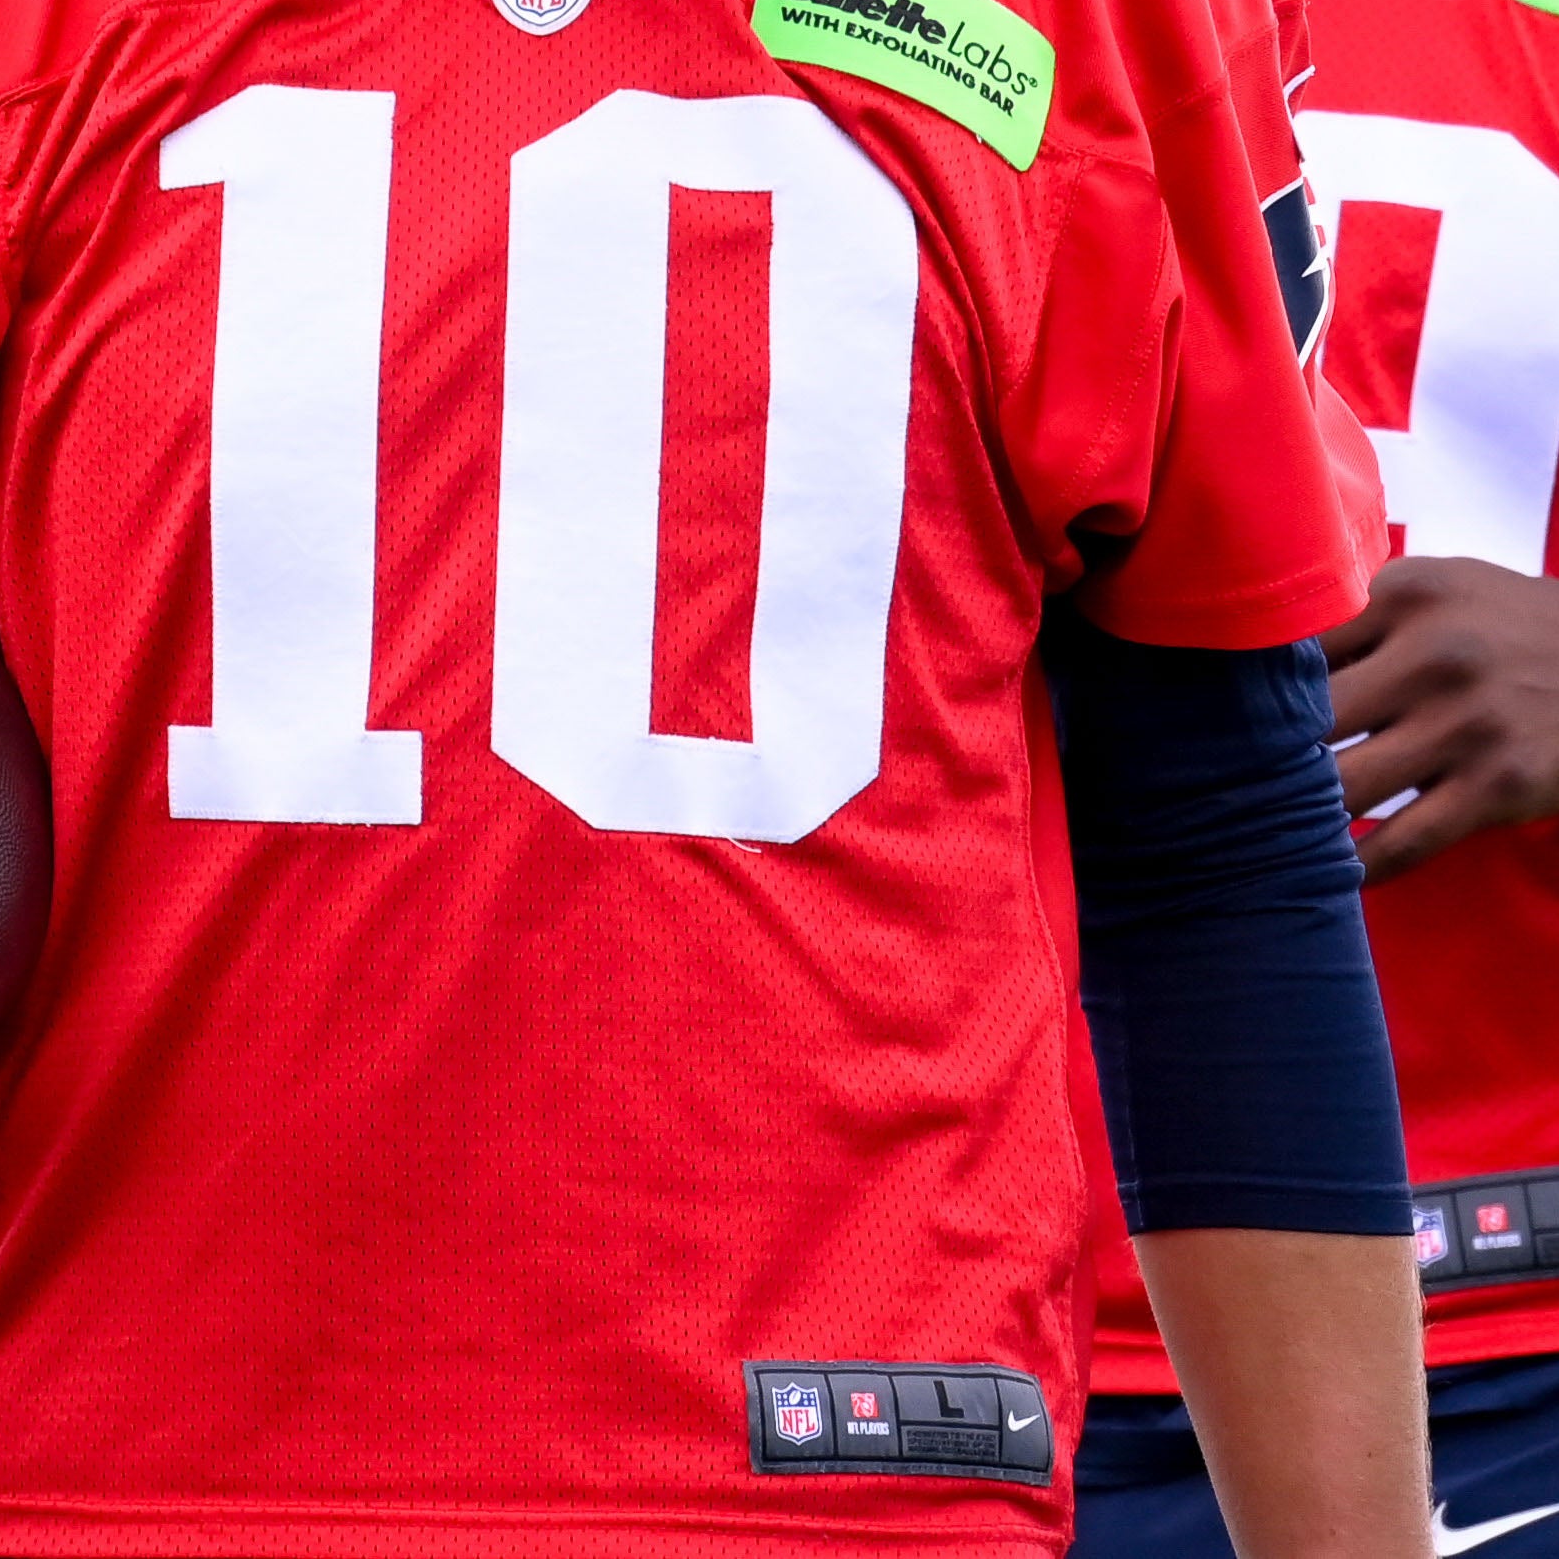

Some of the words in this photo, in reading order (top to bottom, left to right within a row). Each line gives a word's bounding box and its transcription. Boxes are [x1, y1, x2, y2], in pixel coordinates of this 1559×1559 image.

[781, 6, 840, 33] WITH
[844, 22, 976, 90] EXFOLIATING
[979, 84, 1016, 118] BAR
[159, 83, 920, 845] 10
[781, 1408, 816, 1432] NFL
[933, 1380, 965, 1419] L
